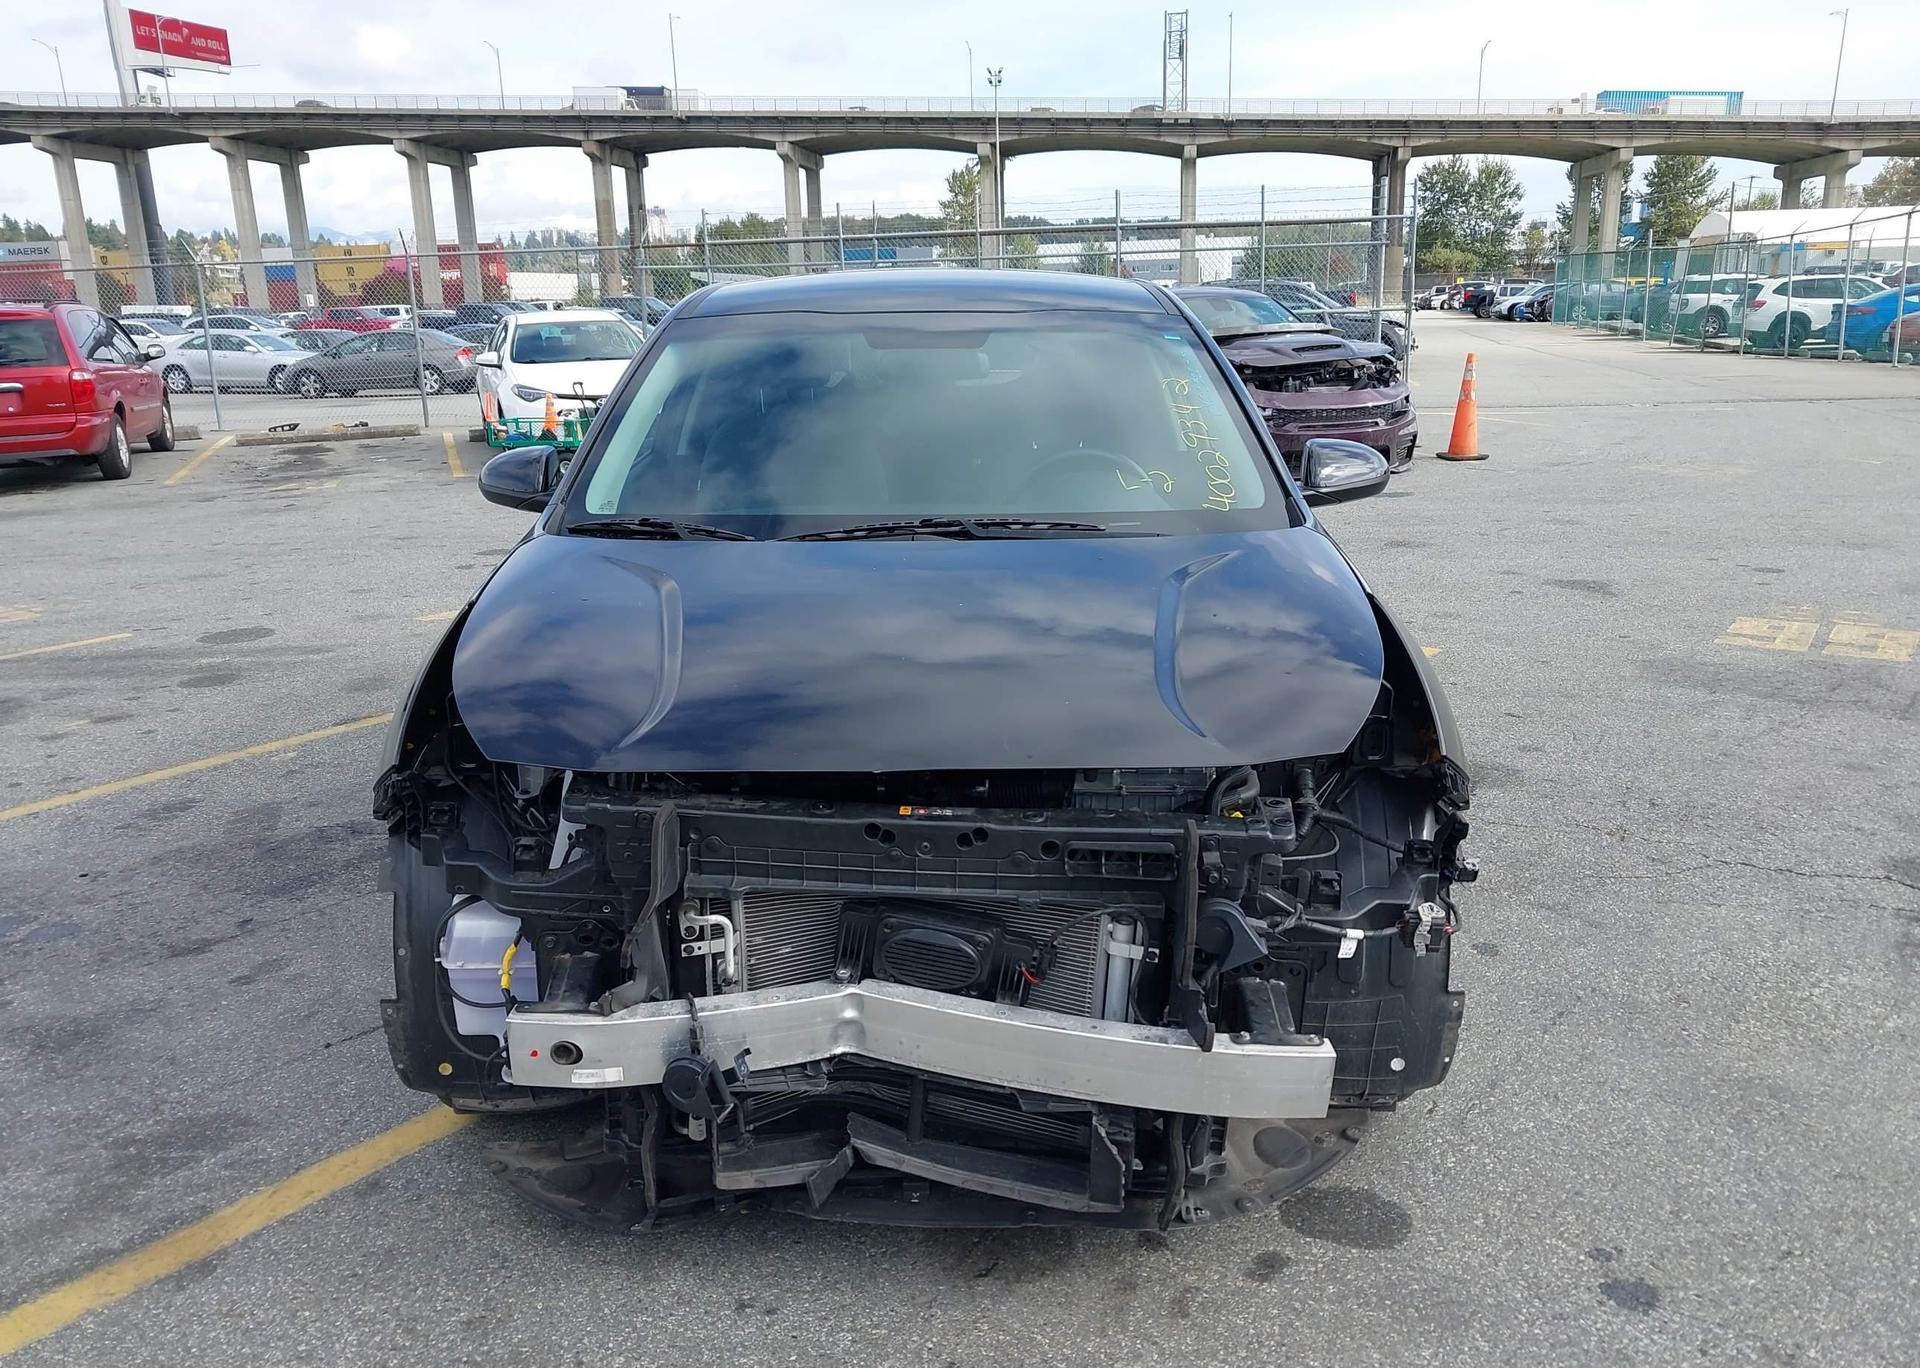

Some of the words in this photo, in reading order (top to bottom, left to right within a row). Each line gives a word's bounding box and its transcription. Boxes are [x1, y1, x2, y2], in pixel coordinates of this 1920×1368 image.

[136, 24, 156, 38] LET'S
[191, 36, 206, 47] AND
[207, 40, 225, 51] ROLL
[8, 247, 50, 256] MAERSK
